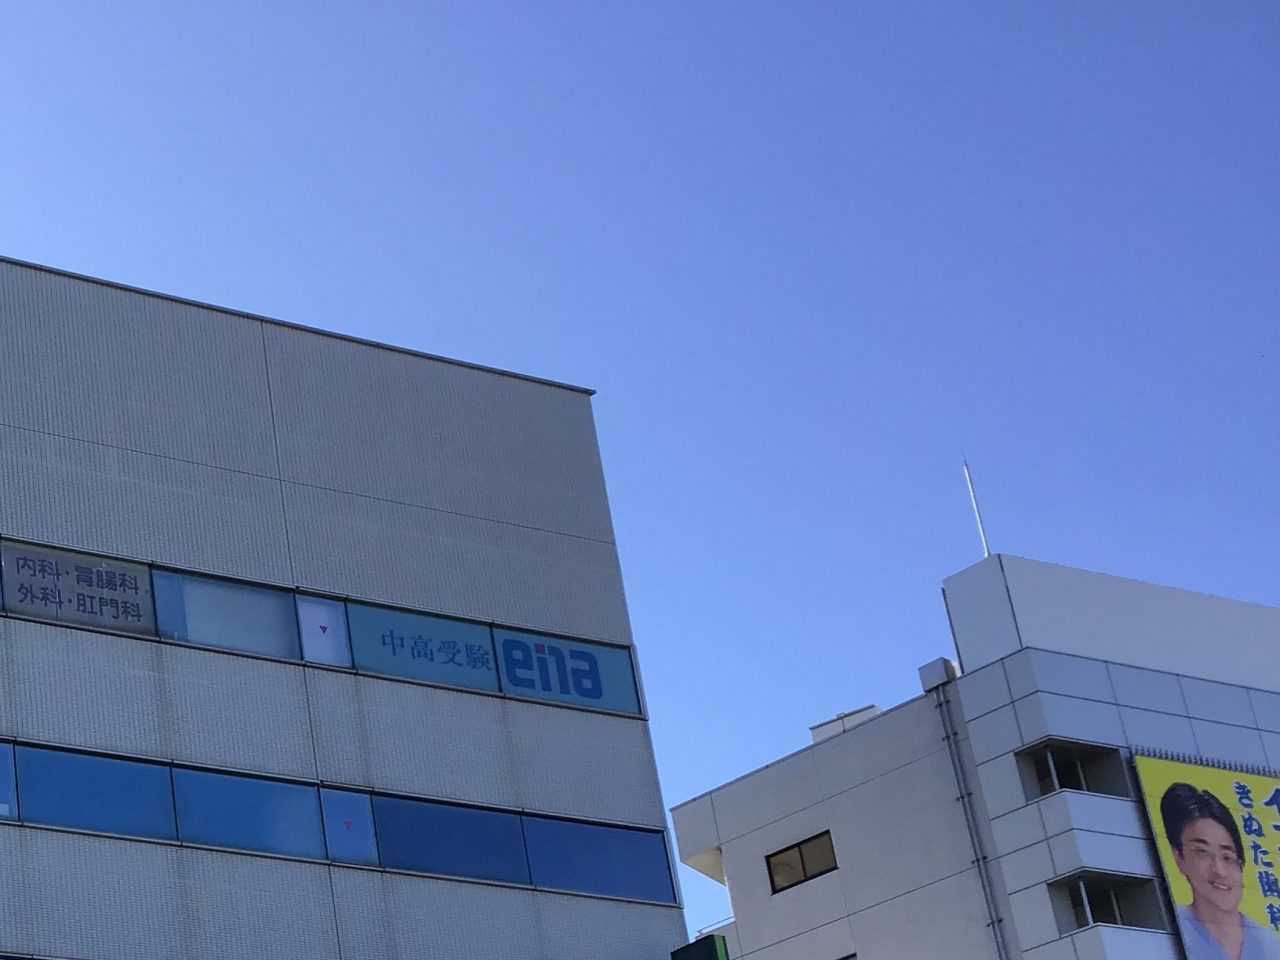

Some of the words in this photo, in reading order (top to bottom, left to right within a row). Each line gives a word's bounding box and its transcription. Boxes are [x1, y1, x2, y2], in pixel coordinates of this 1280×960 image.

[381, 629, 493, 671] 中高受験
[502, 638, 603, 700] ena
